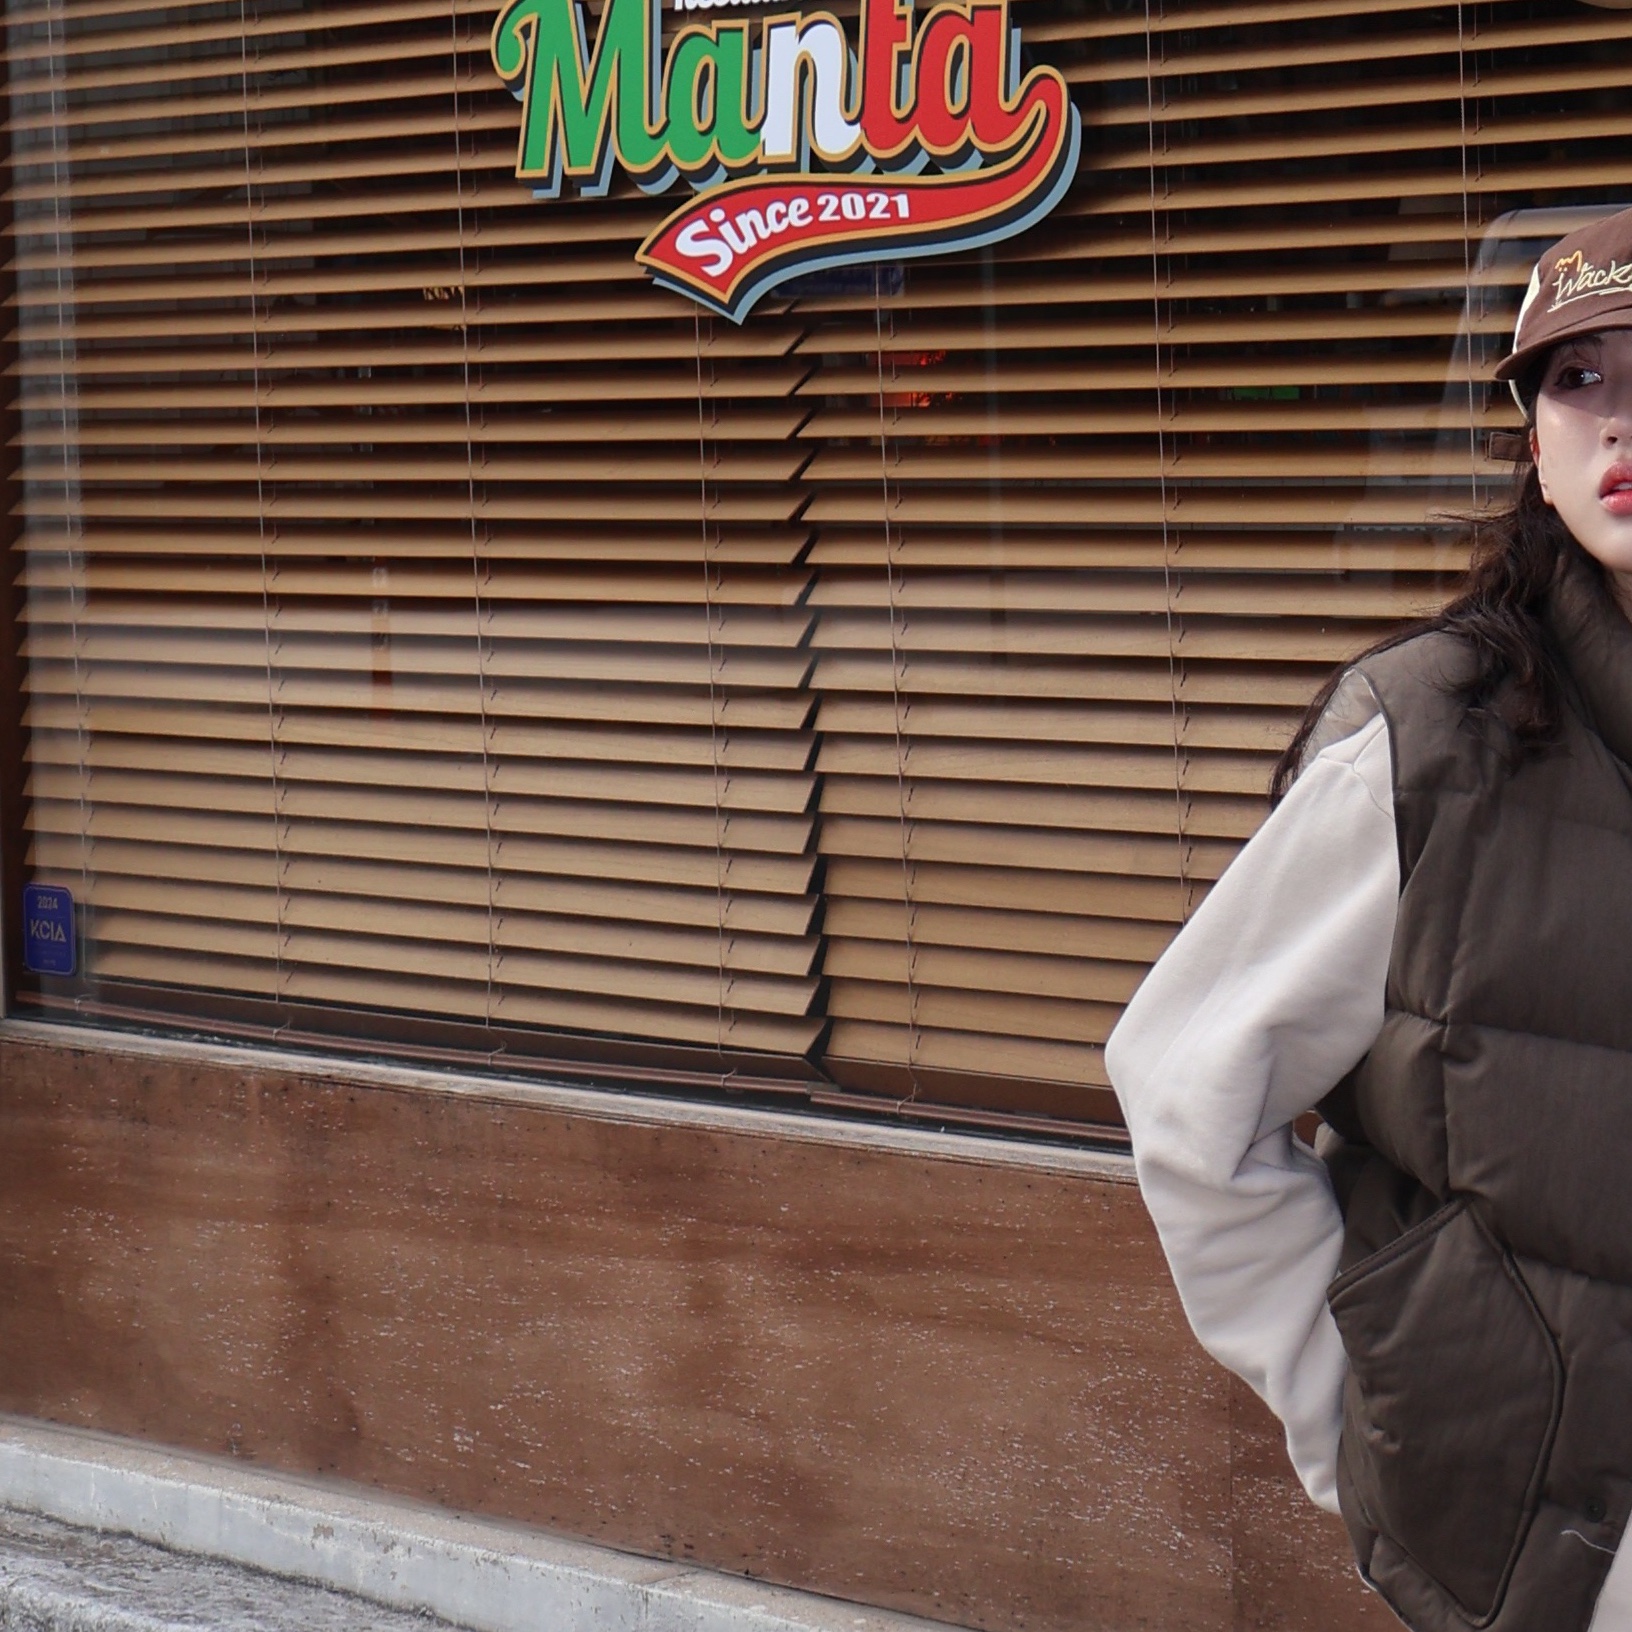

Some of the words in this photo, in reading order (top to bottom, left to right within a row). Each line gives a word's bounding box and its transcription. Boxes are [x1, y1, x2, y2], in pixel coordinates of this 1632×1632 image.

[491, 0, 1030, 182] Manta
[675, 196, 814, 277] Since
[817, 192, 911, 223] 2021
[30, 918, 67, 942] KCIA
